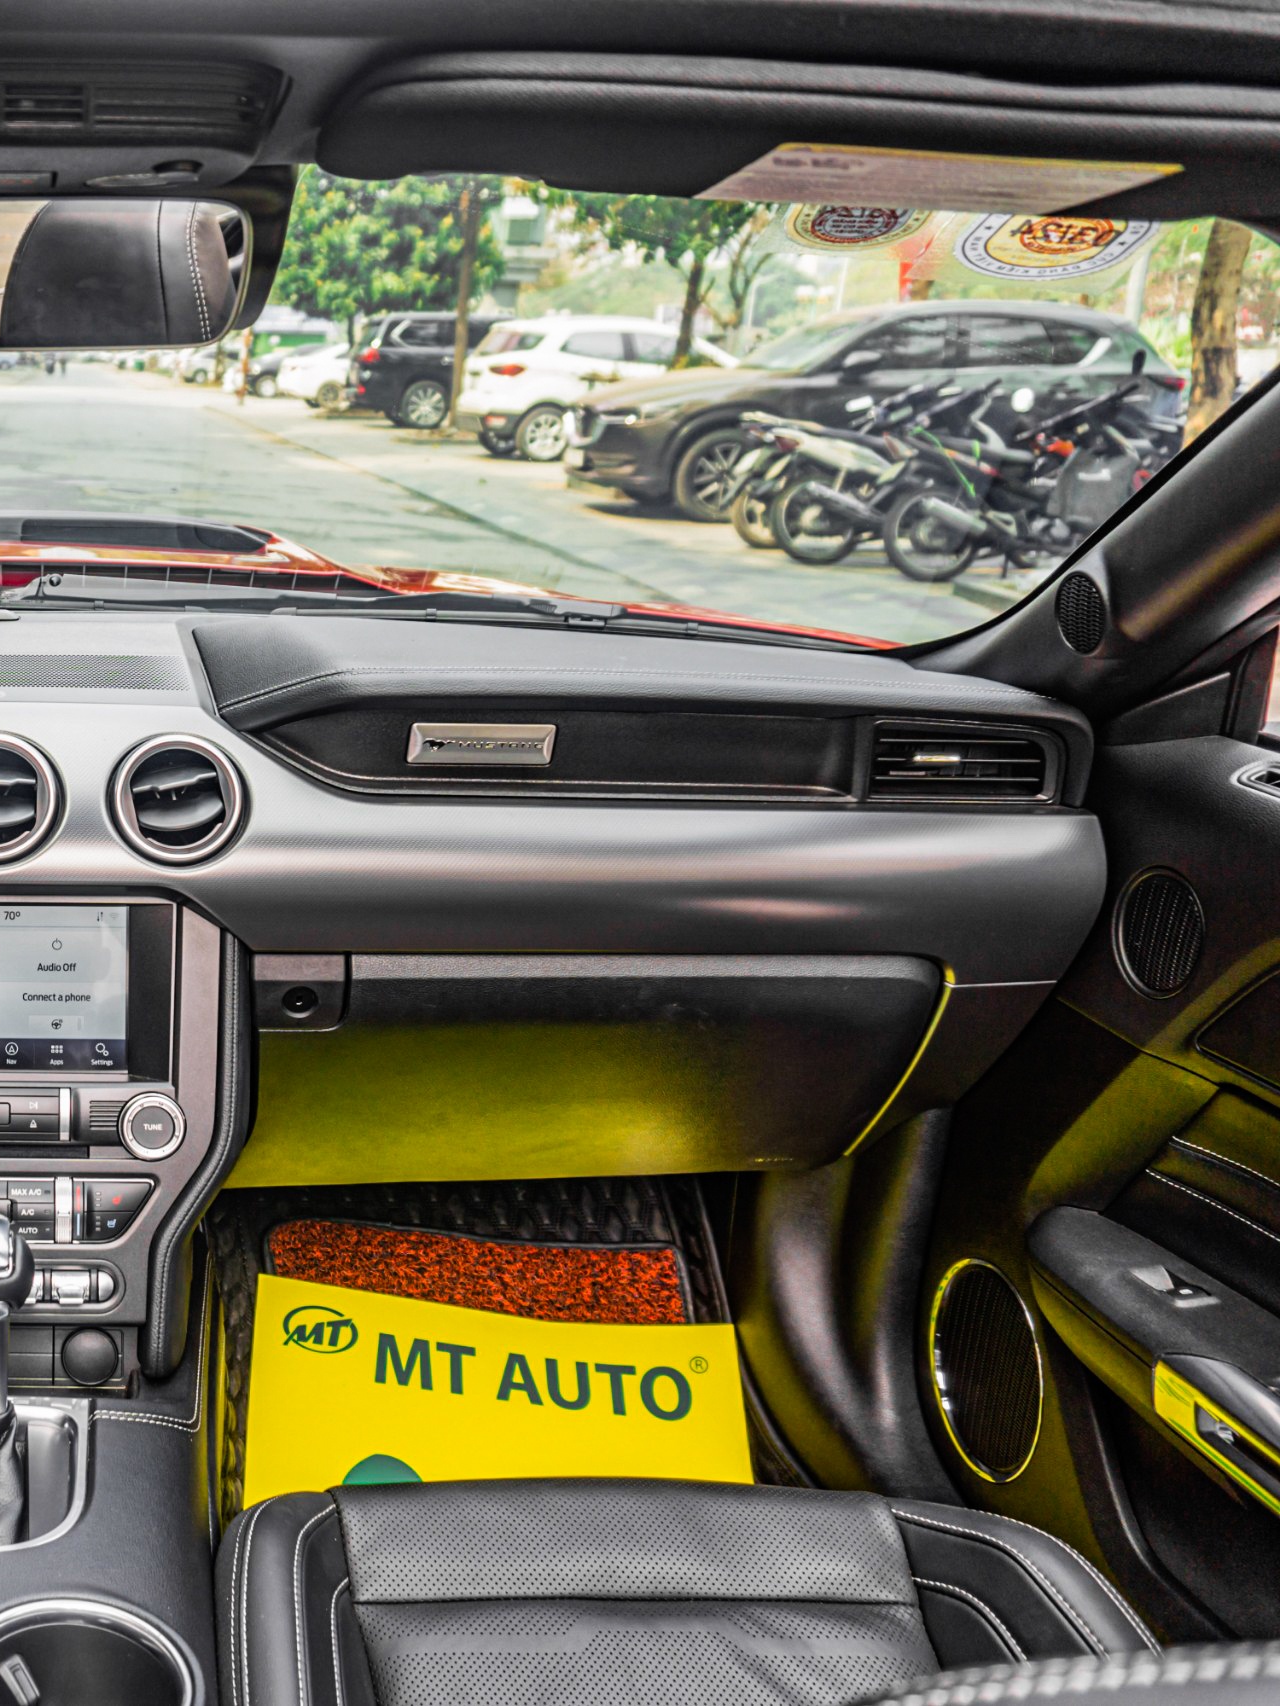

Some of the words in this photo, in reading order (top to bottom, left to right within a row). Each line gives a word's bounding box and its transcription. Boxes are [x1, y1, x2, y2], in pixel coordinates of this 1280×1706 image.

[459, 740, 545, 750] MUSTANG
[37, 962, 62, 972] Audio
[63, 962, 77, 972] Off
[22, 992, 57, 1002] Connect
[58, 994, 64, 1002] a
[65, 992, 91, 1004] phone
[6, 1058, 17, 1066] Nav
[49, 1058, 64, 1067] Apps
[90, 1058, 114, 1067] Settings
[143, 1123, 163, 1131] TUNE
[11, 1188, 27, 1196] MAX
[28, 1188, 42, 1196] A/C
[20, 1208, 35, 1217] A/C
[374, 1332, 477, 1395] MT
